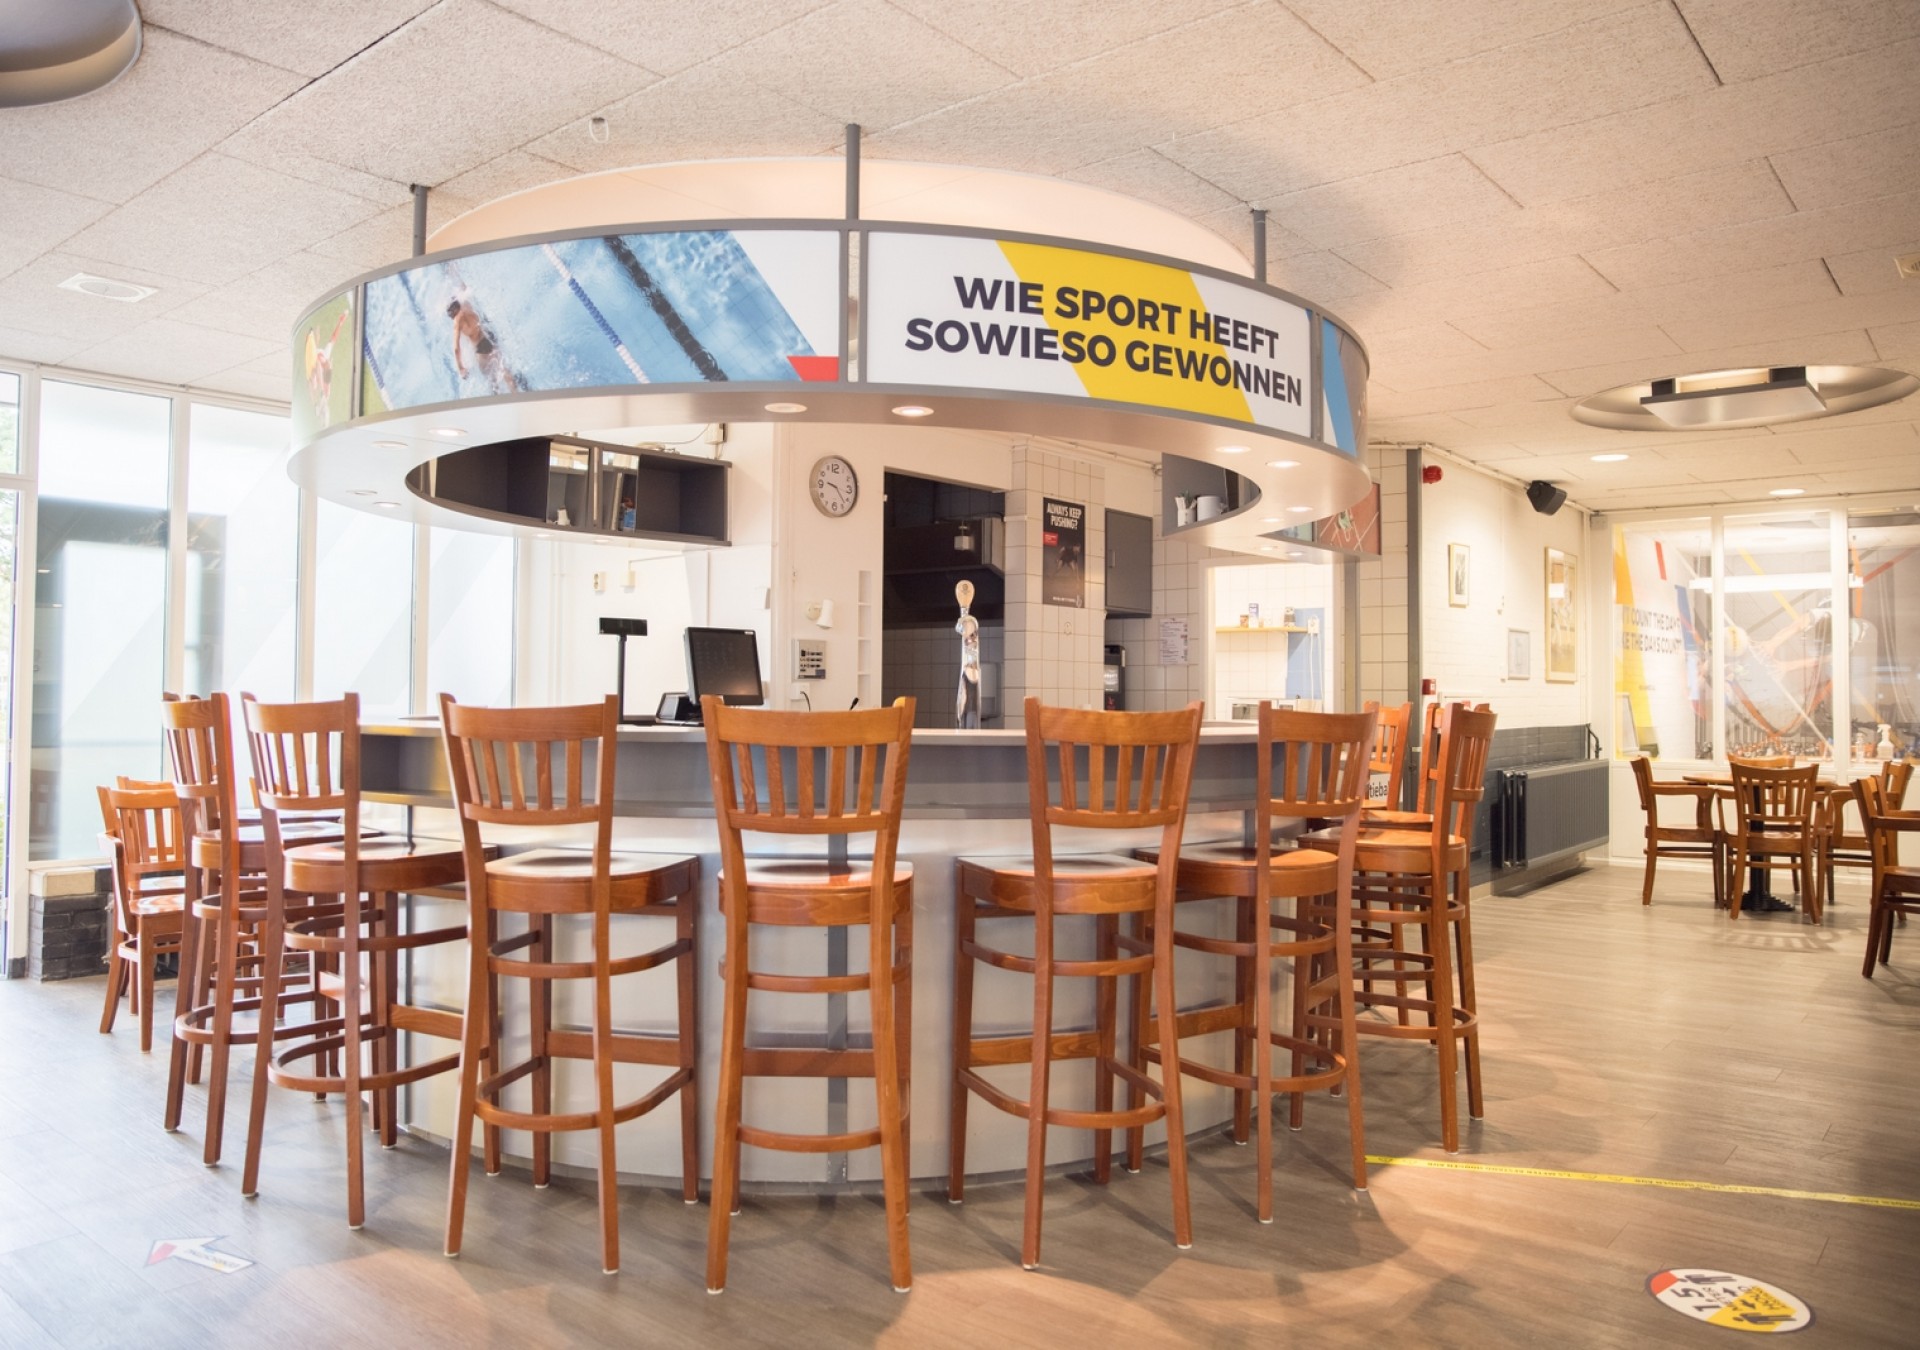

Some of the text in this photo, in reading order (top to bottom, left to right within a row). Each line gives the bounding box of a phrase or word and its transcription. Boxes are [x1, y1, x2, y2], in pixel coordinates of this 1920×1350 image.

[953, 275, 1280, 360] WIE SPORT HEEFT
[904, 317, 1303, 407] SOWIESO GEWONNEN
[832, 463, 840, 474] 12
[1047, 503, 1082, 519] ALWAYS KEEP
